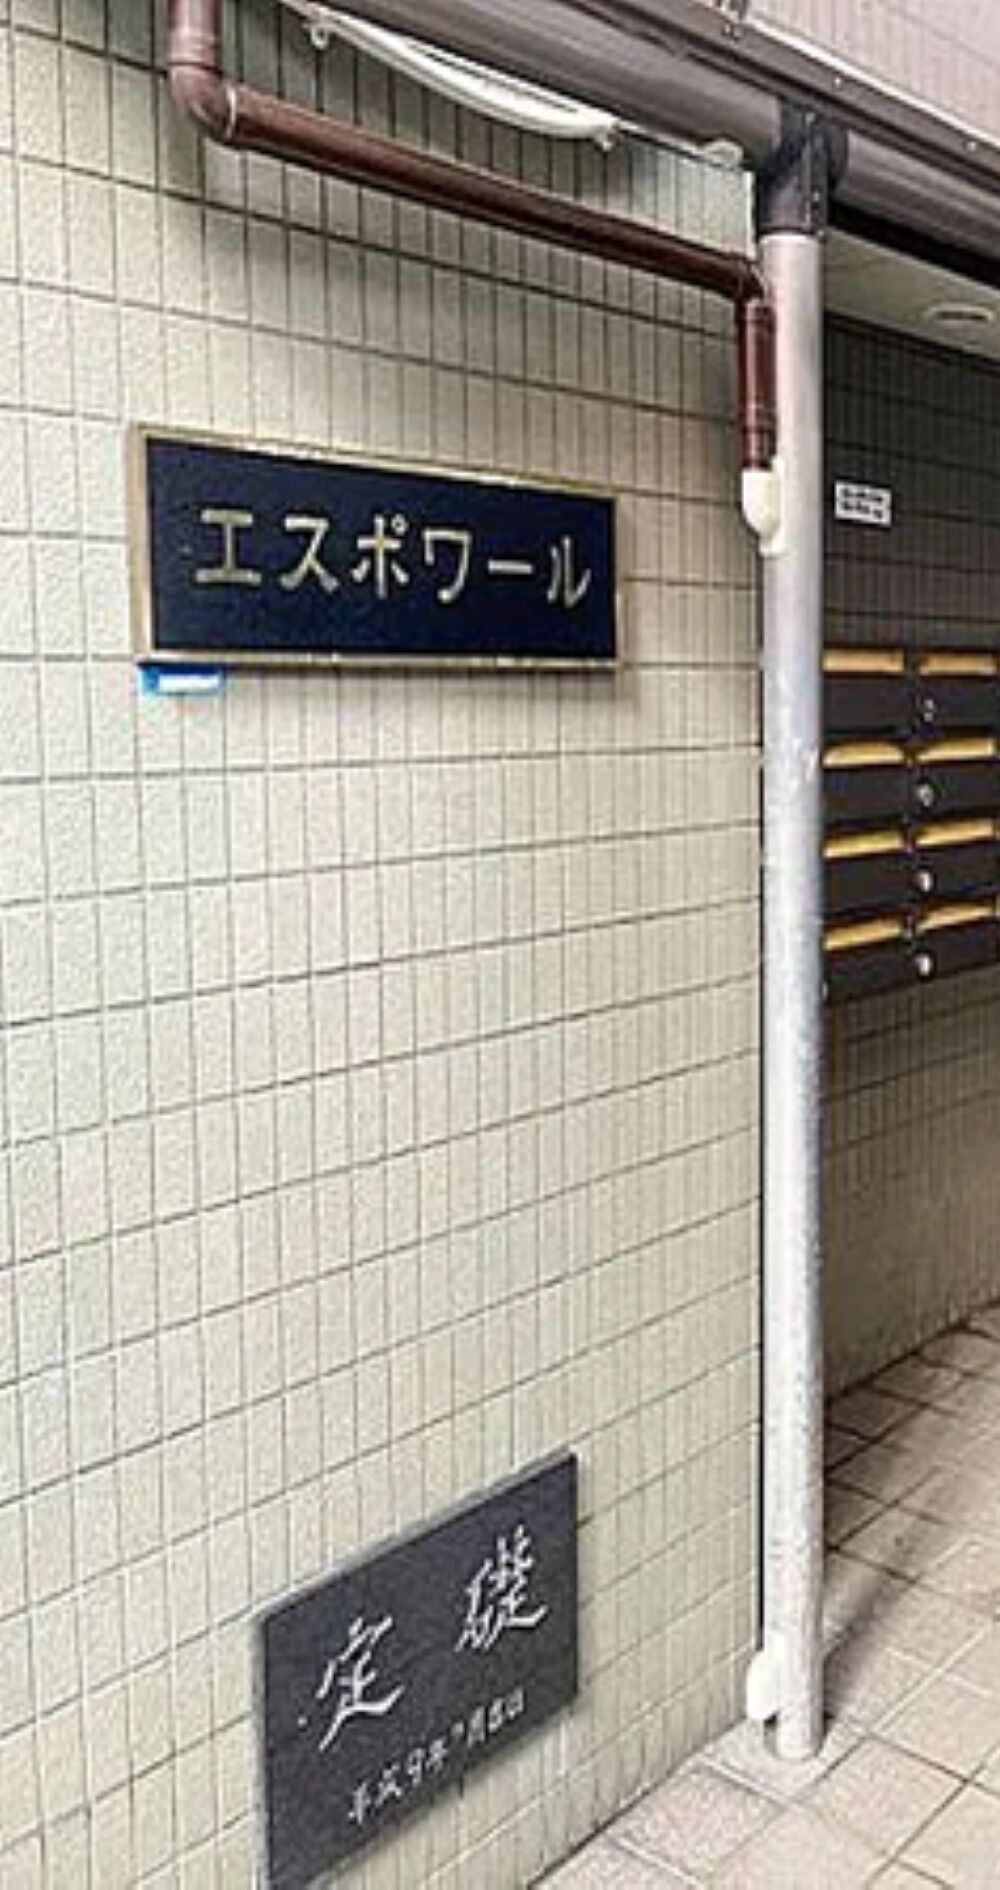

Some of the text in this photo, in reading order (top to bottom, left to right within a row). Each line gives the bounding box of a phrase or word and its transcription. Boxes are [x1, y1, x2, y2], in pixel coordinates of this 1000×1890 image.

[196, 508, 592, 607] エスポワール
[316, 1524, 549, 1752] 定礎
